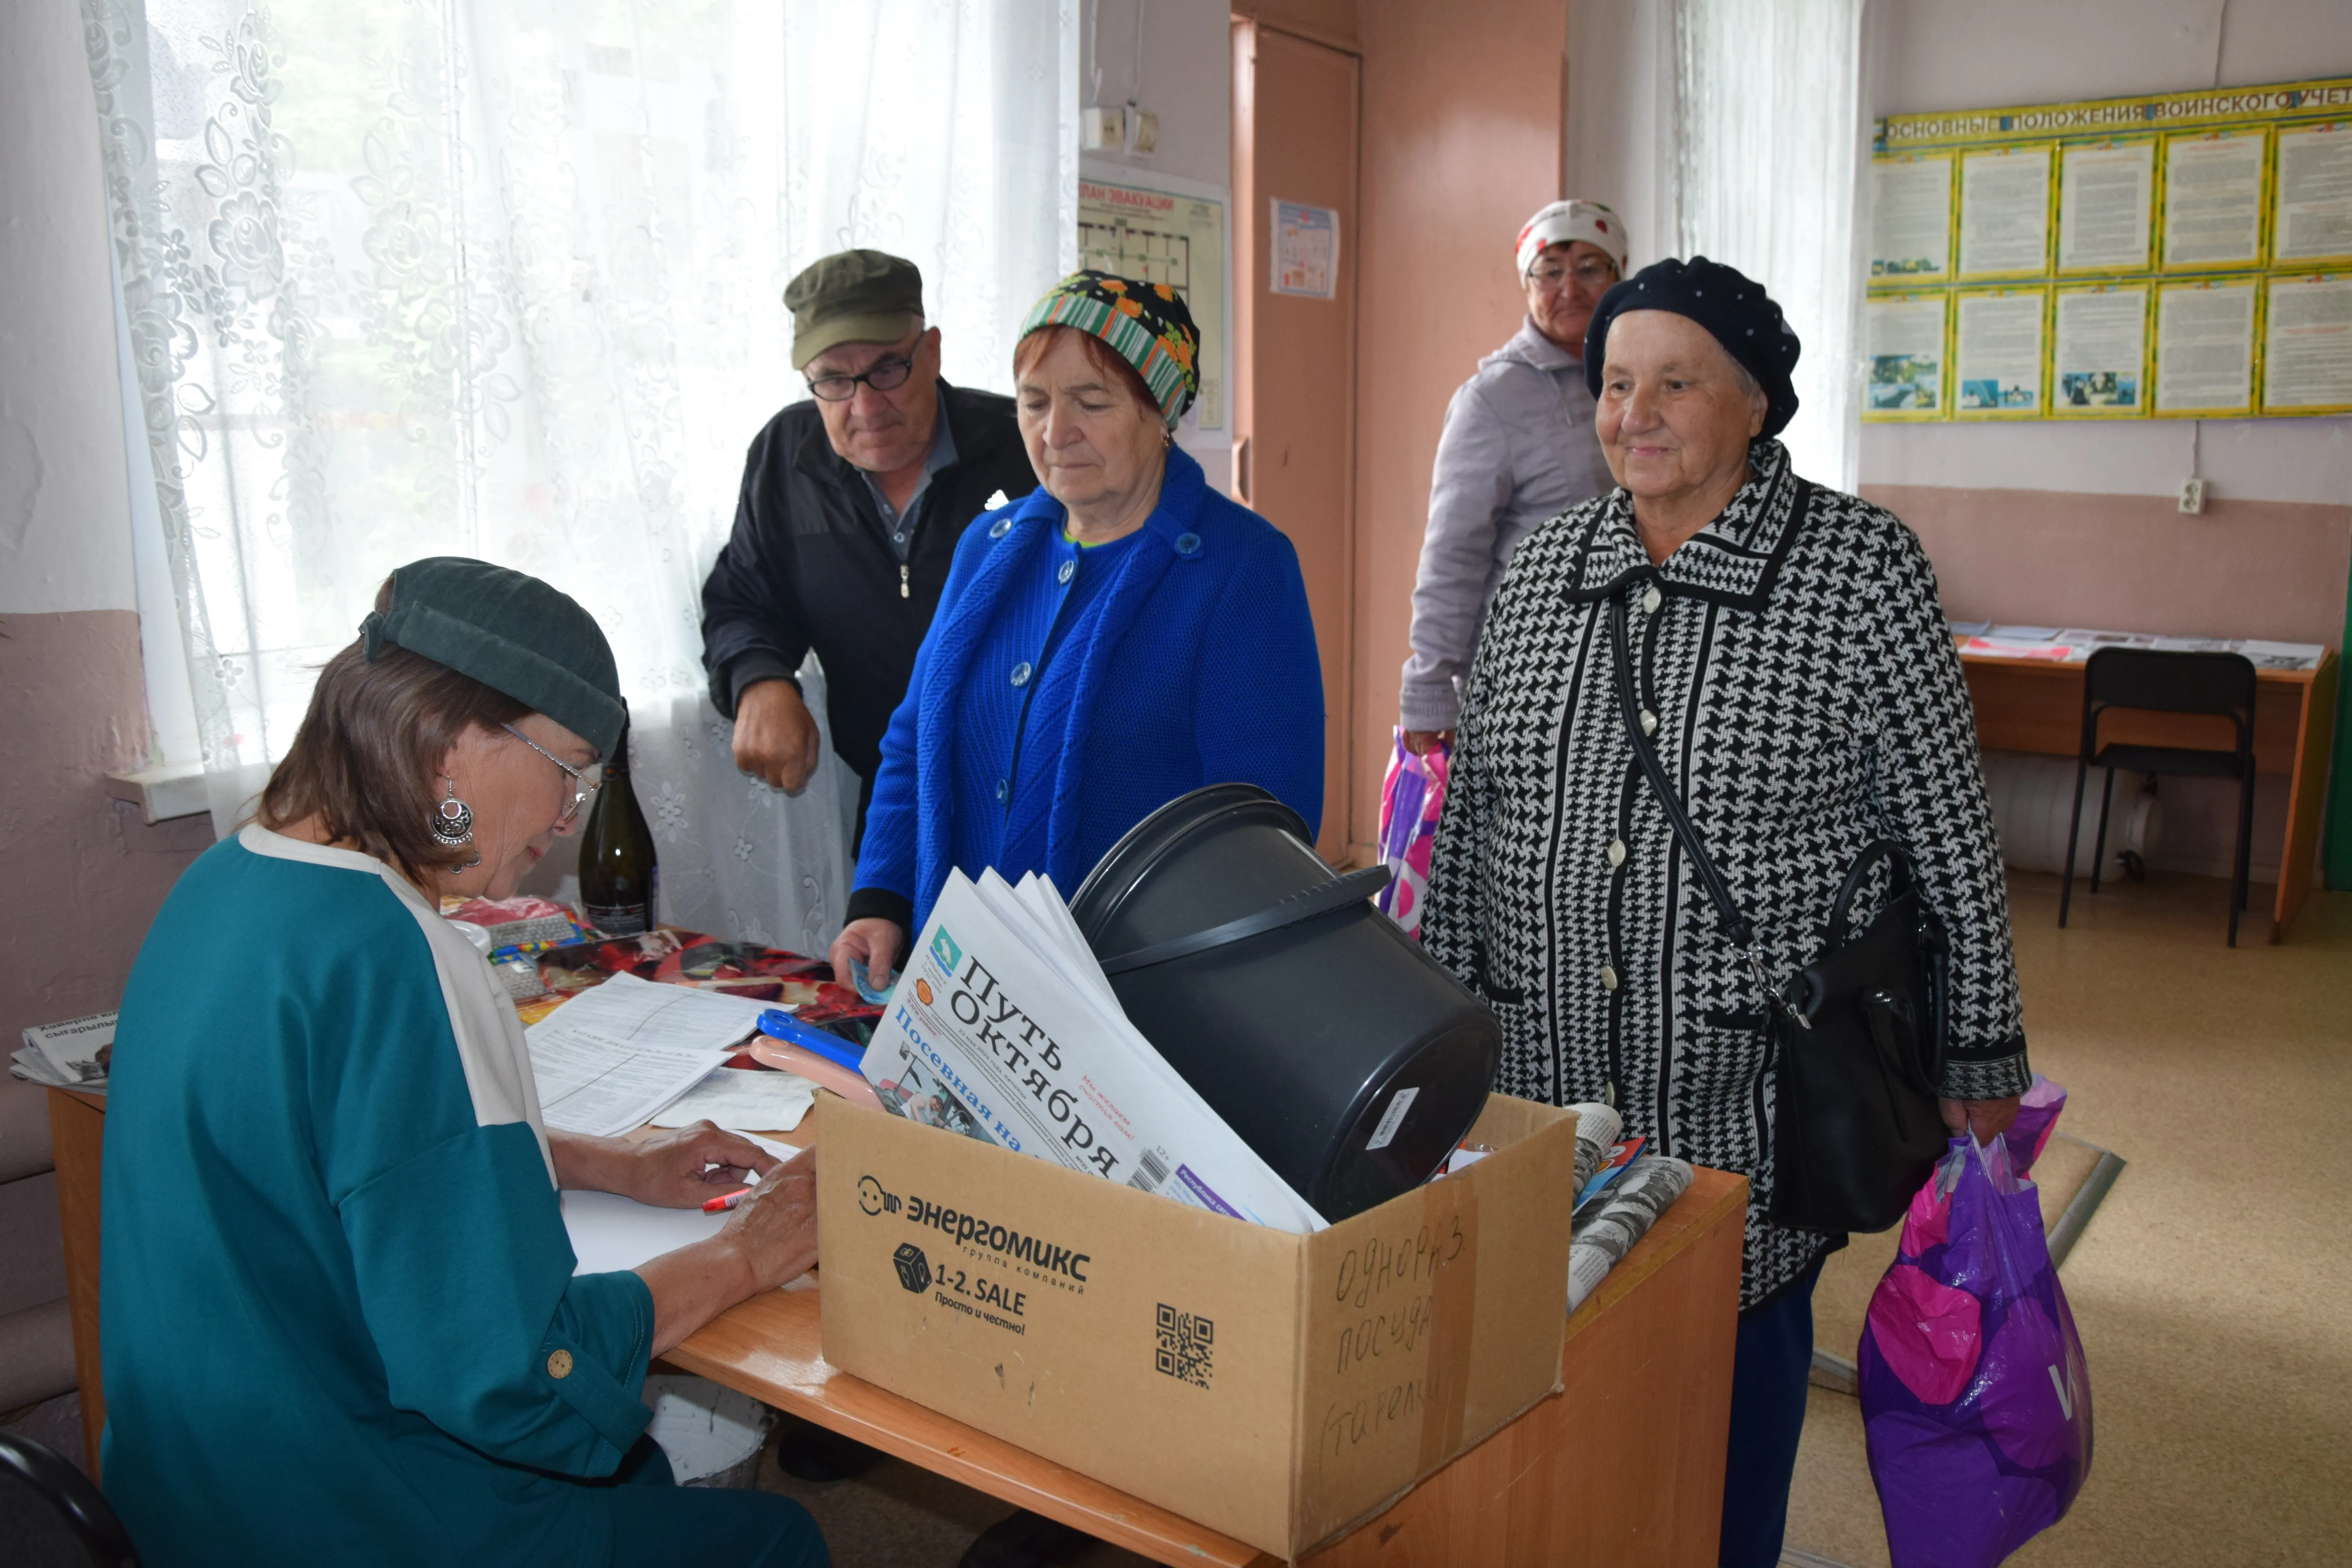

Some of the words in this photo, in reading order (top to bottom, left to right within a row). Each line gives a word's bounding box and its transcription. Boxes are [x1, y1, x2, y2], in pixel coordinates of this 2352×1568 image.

[1887, 116, 1999, 140] ОСНОВНЫЕ
[2012, 105, 2145, 131] ПОЛОЖЕНИЯ
[2154, 91, 2291, 118] ВОИНСКОГО
[1109, 188, 1174, 211] ЭВАКУАЦИИ
[919, 1016, 936, 1036] района
[959, 956, 1062, 1072] Путь
[895, 1004, 993, 1122] Посевная
[994, 1120, 1021, 1152] на
[951, 991, 1119, 1179] Октября
[965, 1036, 976, 1047] мая
[1004, 1074, 1027, 1100] пятница
[1079, 1085, 1113, 1120] счастья
[1082, 1075, 1096, 1091] Мы
[1096, 1091, 1130, 1126] желаем
[1156, 1145, 1169, 1161] 12+
[1180, 1169, 1216, 1206] Республика
[963, 1245, 1008, 1268] группа
[1016, 1265, 1084, 1295] компаний
[935, 1291, 973, 1315] Просто
[975, 1309, 981, 1318] и
[983, 1311, 1025, 1336] честно!
